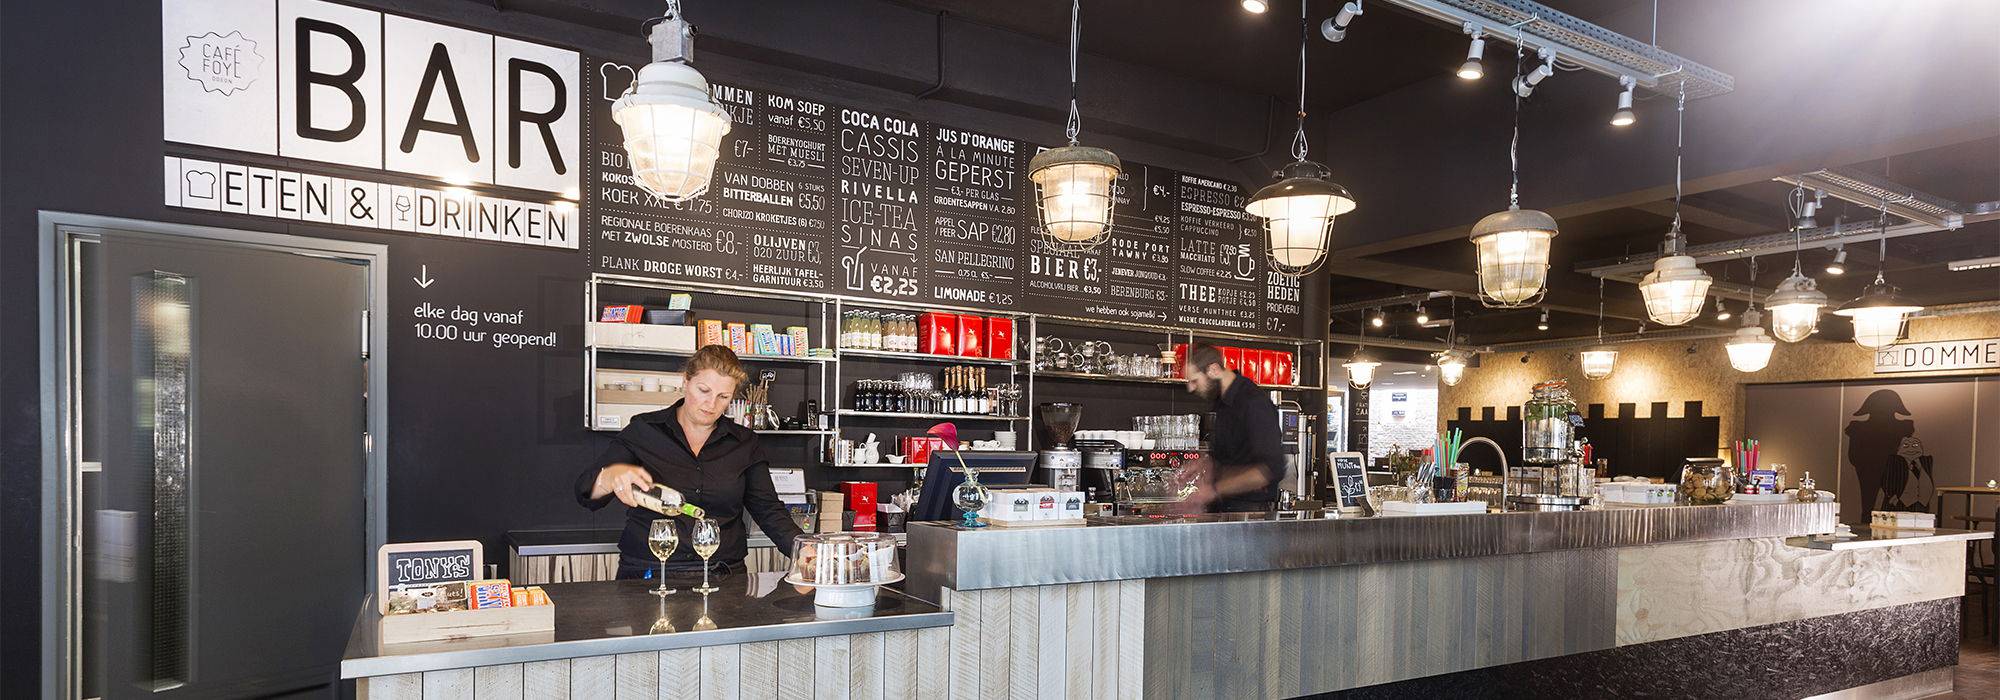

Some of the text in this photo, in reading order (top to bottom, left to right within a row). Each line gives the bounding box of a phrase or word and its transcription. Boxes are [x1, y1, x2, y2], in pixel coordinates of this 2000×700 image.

[296, 17, 566, 176] BAR
[768, 94, 825, 116] KOM SOEP
[768, 114, 794, 126] vanaf
[841, 108, 919, 138] COCA COLA
[768, 134, 826, 152] BOERENYOGHURT
[936, 128, 957, 143] JUS
[767, 143, 825, 162] MET MUESLI
[841, 128, 919, 163] CASSIS
[601, 151, 623, 168] BIO
[950, 147, 966, 161] LA
[972, 151, 1015, 169] MINUTE
[841, 155, 920, 186] SEVEN-UP
[935, 159, 1015, 190] GEPERST
[724, 171, 825, 193] VAN DOBBEN 6 STUKS
[1181, 174, 1197, 185] KOFFIE
[1197, 178, 1223, 190] AMERICANO
[601, 187, 640, 205] KOEK
[723, 187, 794, 207] BITTERBALLEN
[841, 179, 918, 205] RIVELLA
[965, 187, 980, 199] PER
[981, 190, 1000, 201] GLAS
[1181, 185, 1230, 206] ESPRESSO
[225, 171, 567, 242] ETEN & DRINKEN
[933, 195, 988, 212] GROENTESAPPEN
[1181, 201, 1241, 220] ESPRESSO-ESPRESSO
[755, 212, 797, 226] KROKETJES
[797, 217, 808, 228] (6)
[841, 197, 918, 232] ICE-TEA
[934, 216, 955, 228] APPEL
[1180, 215, 1235, 231] KOFFIE VERKEERD
[601, 215, 712, 239] REGIONALE BOERENKAAS
[939, 227, 956, 238] PEER
[957, 219, 989, 241] SAP
[1180, 223, 1220, 237] CAPPUCCINO
[601, 230, 713, 252] MET ZWOLSE MOSTERD
[716, 230, 743, 256] €8,-
[753, 234, 806, 251] OLIJVEN
[841, 224, 918, 251] SINAS
[1112, 237, 1170, 254] RODE PORT
[1180, 237, 1216, 255] LATTE
[775, 248, 806, 262] ZUUR
[934, 248, 1015, 271] SAN PELLEGRINO
[1112, 247, 1147, 260] TAWNY
[1180, 251, 1216, 263] MACCHIATO
[601, 255, 640, 271] PLANK
[643, 259, 682, 275] DROGE
[684, 264, 723, 279] WORST
[753, 264, 824, 279] HEERLIJK TAFEL-
[870, 263, 918, 278] VANAF
[1030, 254, 1079, 280] BIER
[1179, 264, 1196, 274] SLOW
[1196, 267, 1215, 277] COFFEE
[752, 273, 801, 287] GARNITUUR
[870, 275, 918, 297] €2,25
[1267, 271, 1300, 288] ZOETIG
[934, 286, 986, 303] LIMONADE
[1110, 285, 1155, 300] BERENBURG
[1179, 283, 1216, 303] THEE
[1217, 287, 1238, 298] KOPJE
[1217, 296, 1237, 306] POTJE
[1267, 285, 1300, 302] HEDEN
[414, 302, 523, 326] elke dag vanaf
[1085, 305, 1095, 313] we
[1096, 305, 1118, 315] hebben
[1118, 307, 1130, 316] ook
[1178, 304, 1200, 314] VERSE
[1203, 307, 1237, 317] MUNTTHEE
[1266, 302, 1300, 315] PROEVERIJ
[1178, 315, 1198, 324] WARME
[1198, 317, 1241, 328] CHOCOLADEMELK
[414, 323, 557, 349] 10.00 uur geopend!
